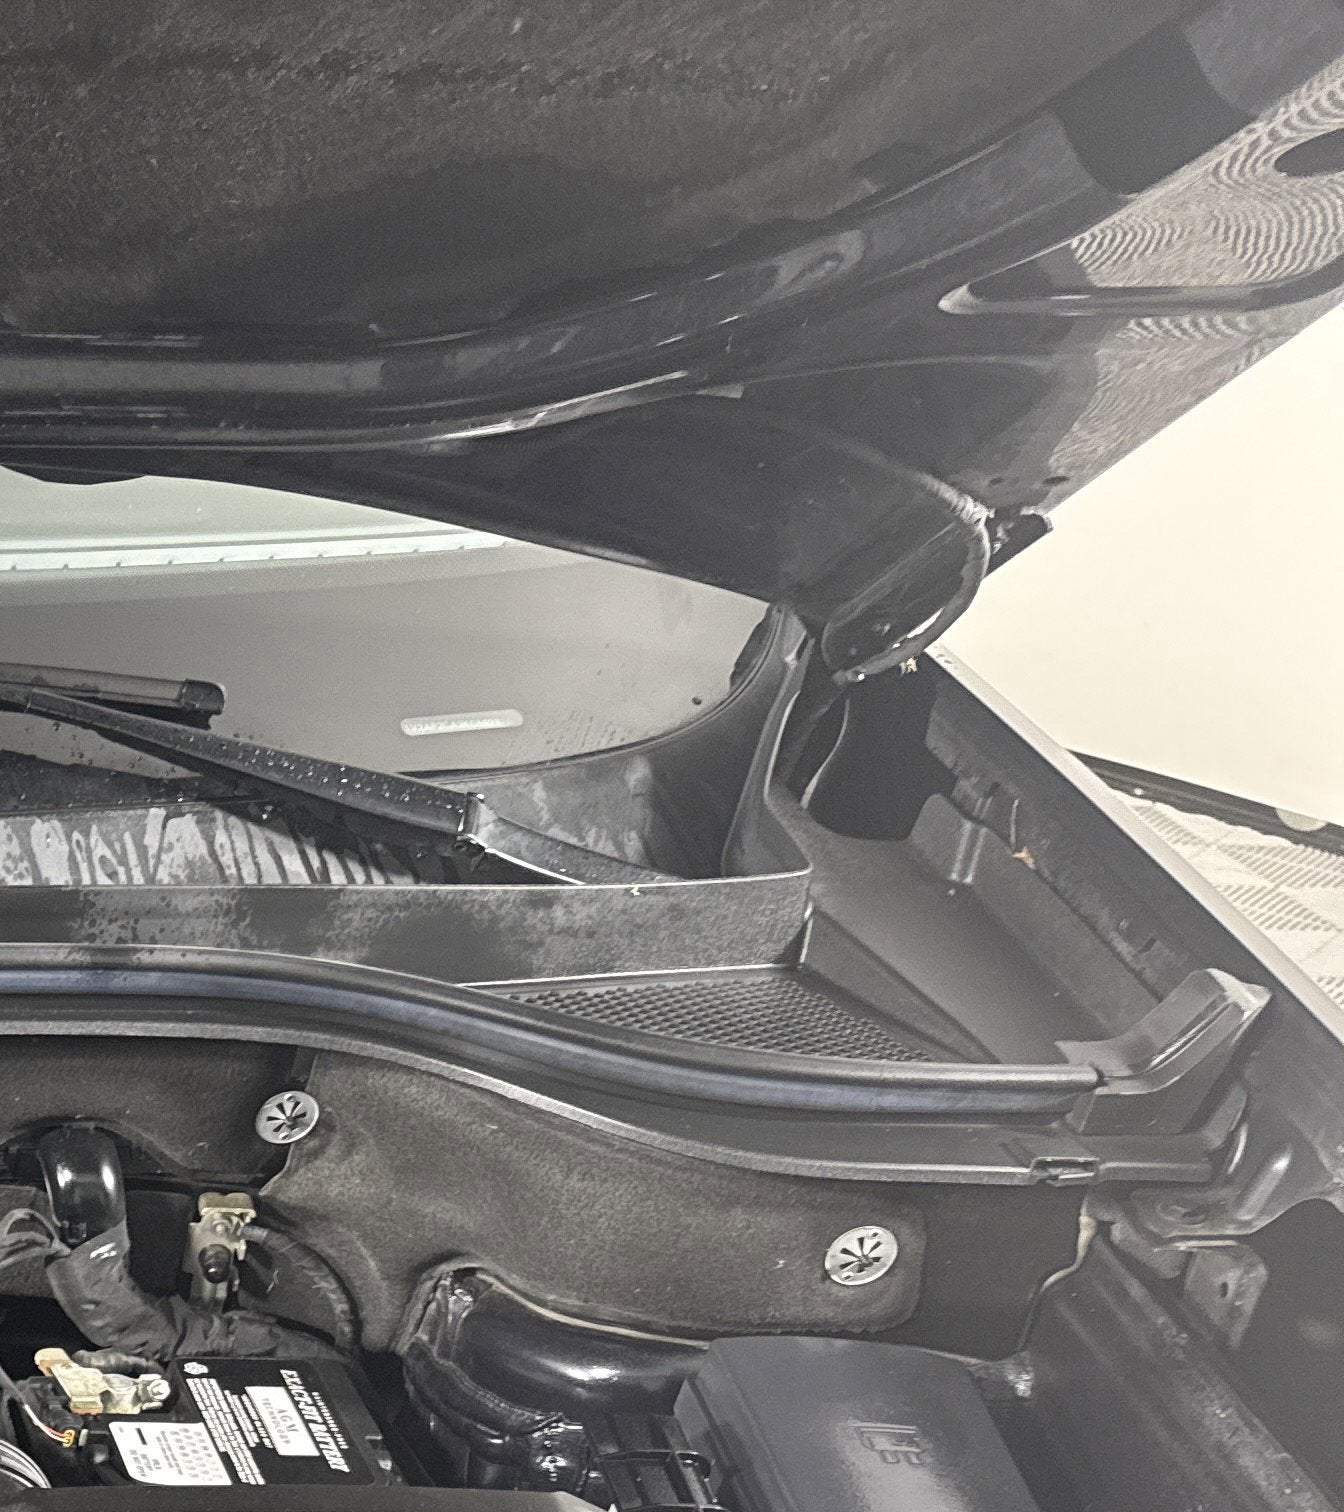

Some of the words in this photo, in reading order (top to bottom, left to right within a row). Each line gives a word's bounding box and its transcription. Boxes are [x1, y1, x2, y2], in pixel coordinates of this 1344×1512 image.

[262, 1398, 291, 1445] TECHNOLOGY
[275, 1408, 299, 1433] AGM
[280, 1369, 324, 1424] EXACT-FIT
[308, 1422, 351, 1473] BATTERY
